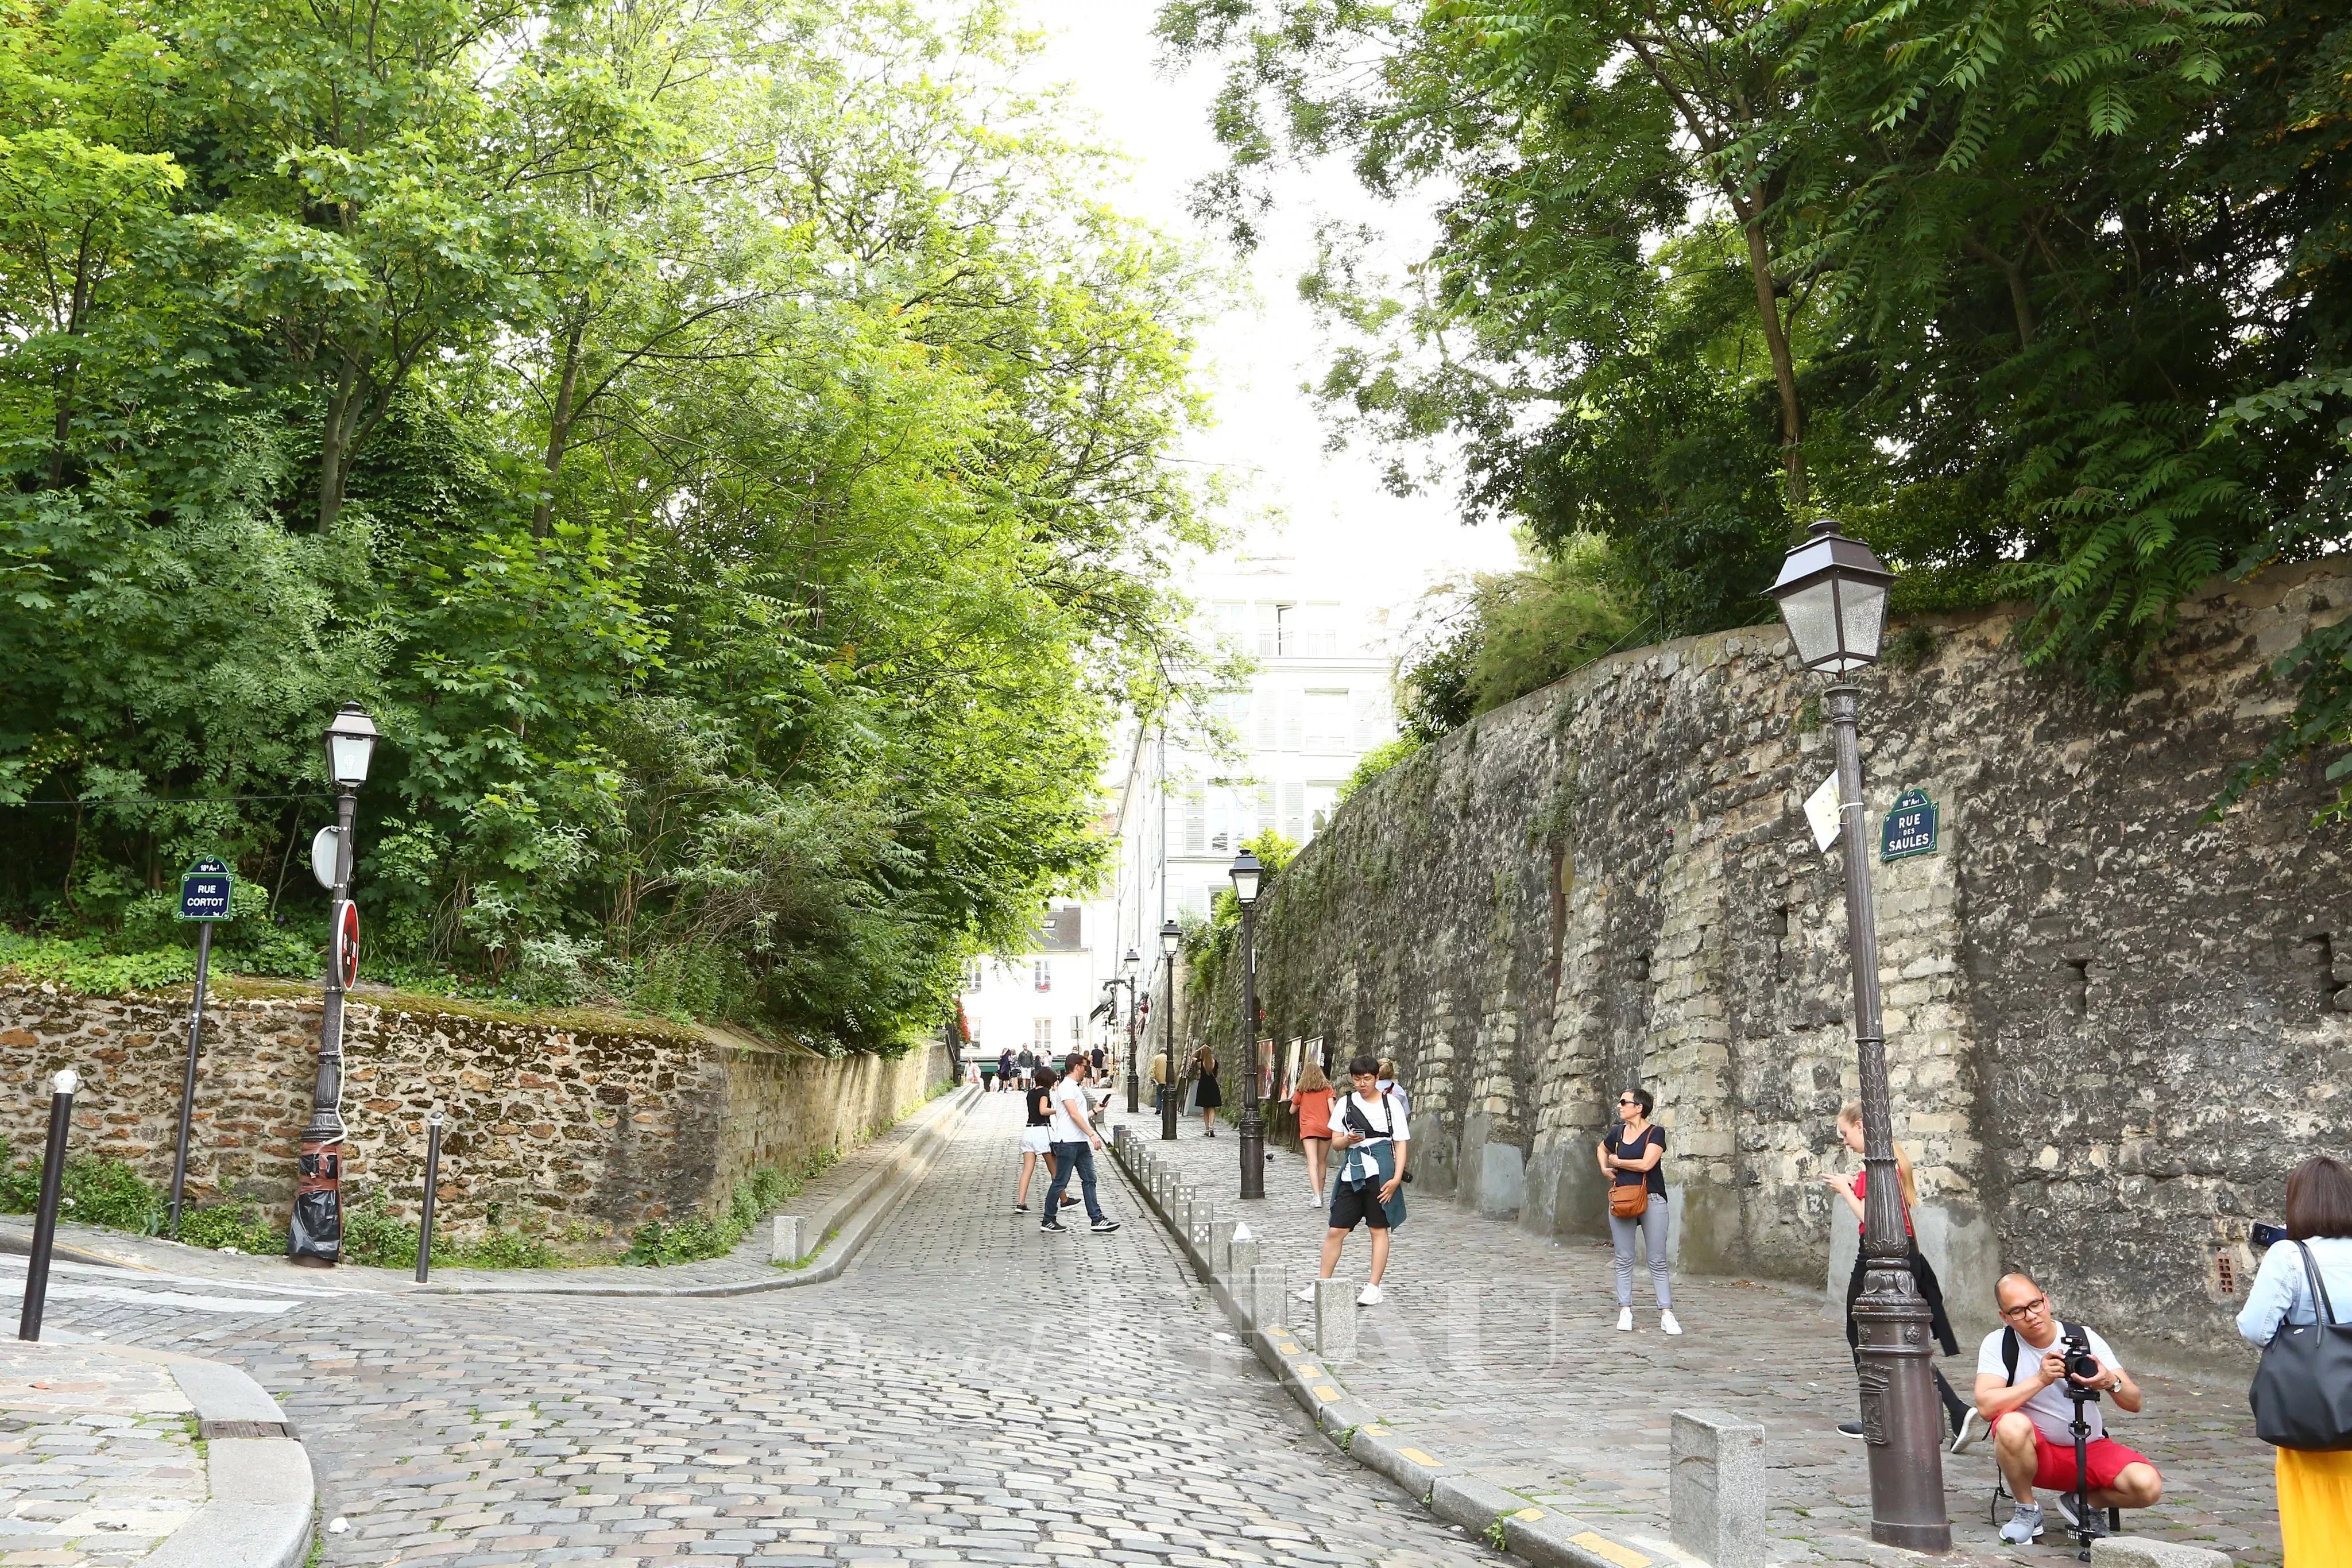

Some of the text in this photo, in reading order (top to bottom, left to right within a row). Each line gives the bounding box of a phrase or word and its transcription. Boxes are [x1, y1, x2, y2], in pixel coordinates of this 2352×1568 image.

[1898, 812, 1921, 829] RUE
[1903, 827, 1916, 837] DES
[1888, 833, 1929, 852] SAULES
[198, 885, 216, 893] RUE
[187, 898, 224, 907] CORTOT
